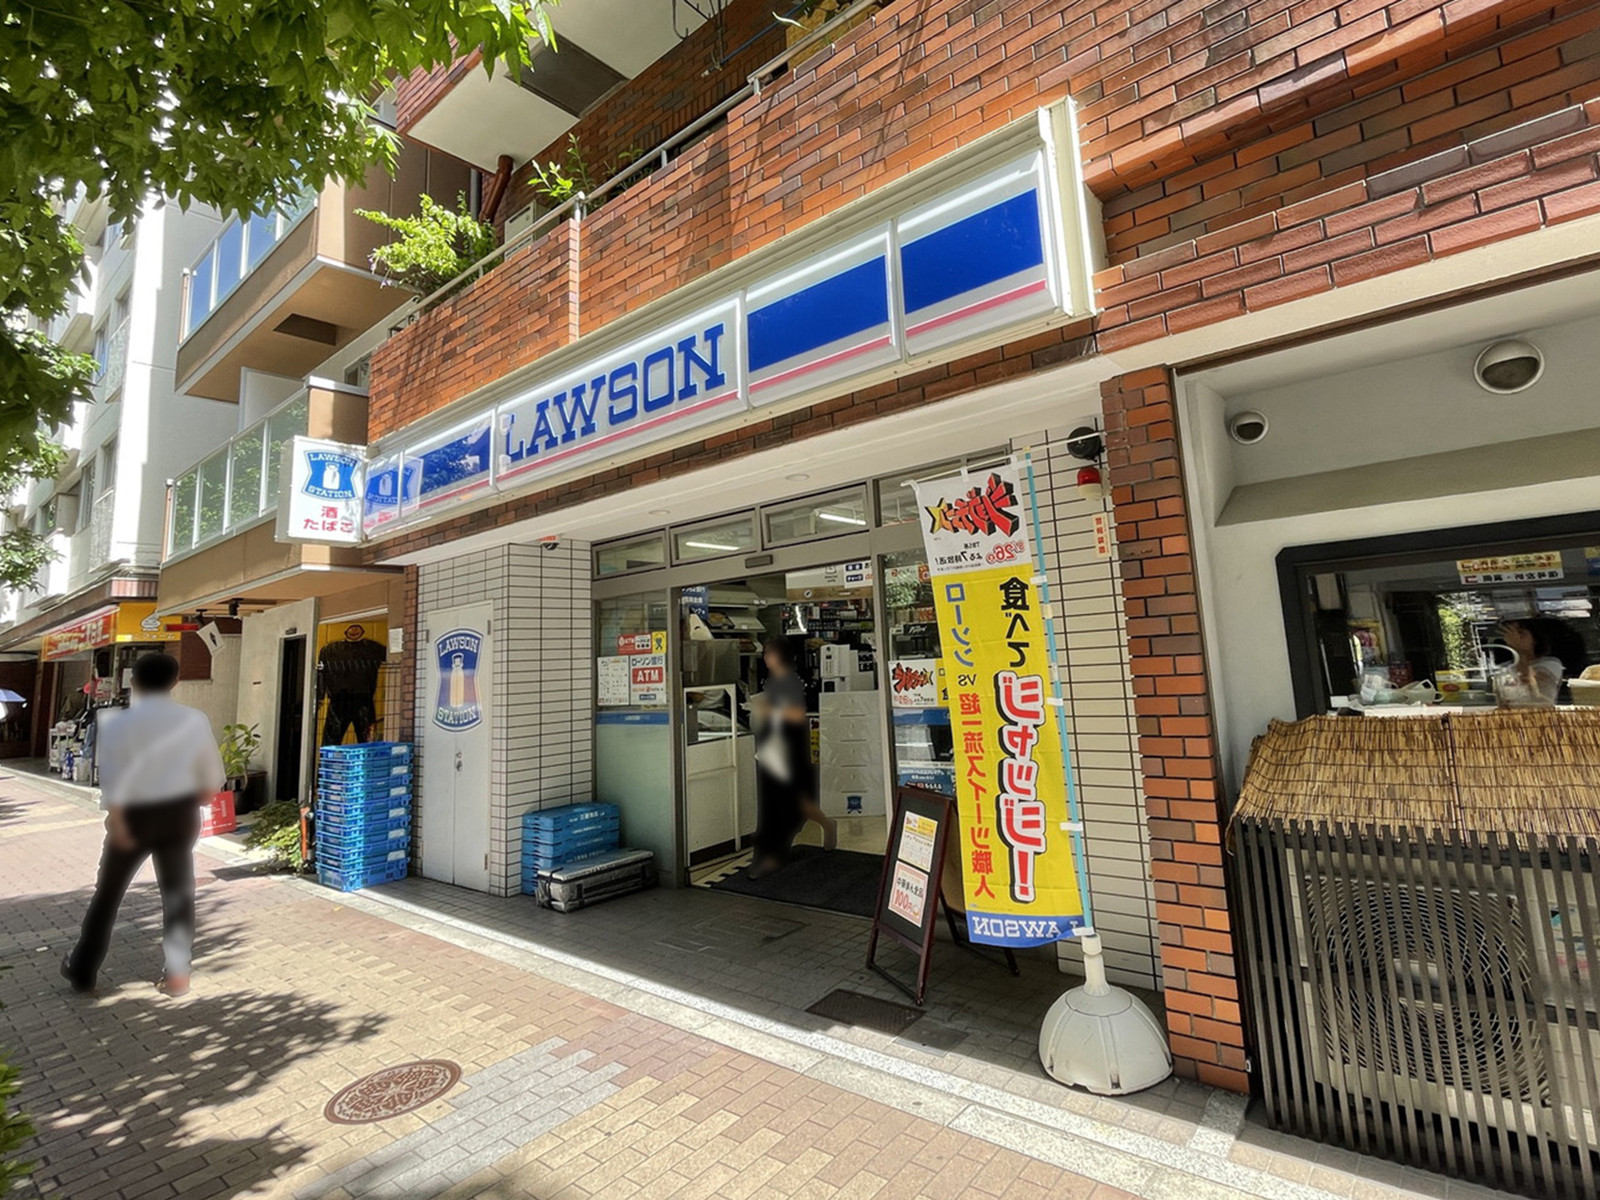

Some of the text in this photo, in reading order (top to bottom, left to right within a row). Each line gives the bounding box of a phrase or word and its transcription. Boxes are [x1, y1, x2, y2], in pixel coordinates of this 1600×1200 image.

[506, 322, 725, 463] LAWSON
[309, 452, 358, 467] LAWSON
[307, 485, 353, 499] STATION
[321, 506, 338, 519] 酒
[303, 518, 354, 533] たばこ
[438, 636, 479, 657] LAWSON
[631, 655, 663, 667] ローソン銀行
[636, 669, 659, 682] ATM
[437, 705, 477, 725] STATION
